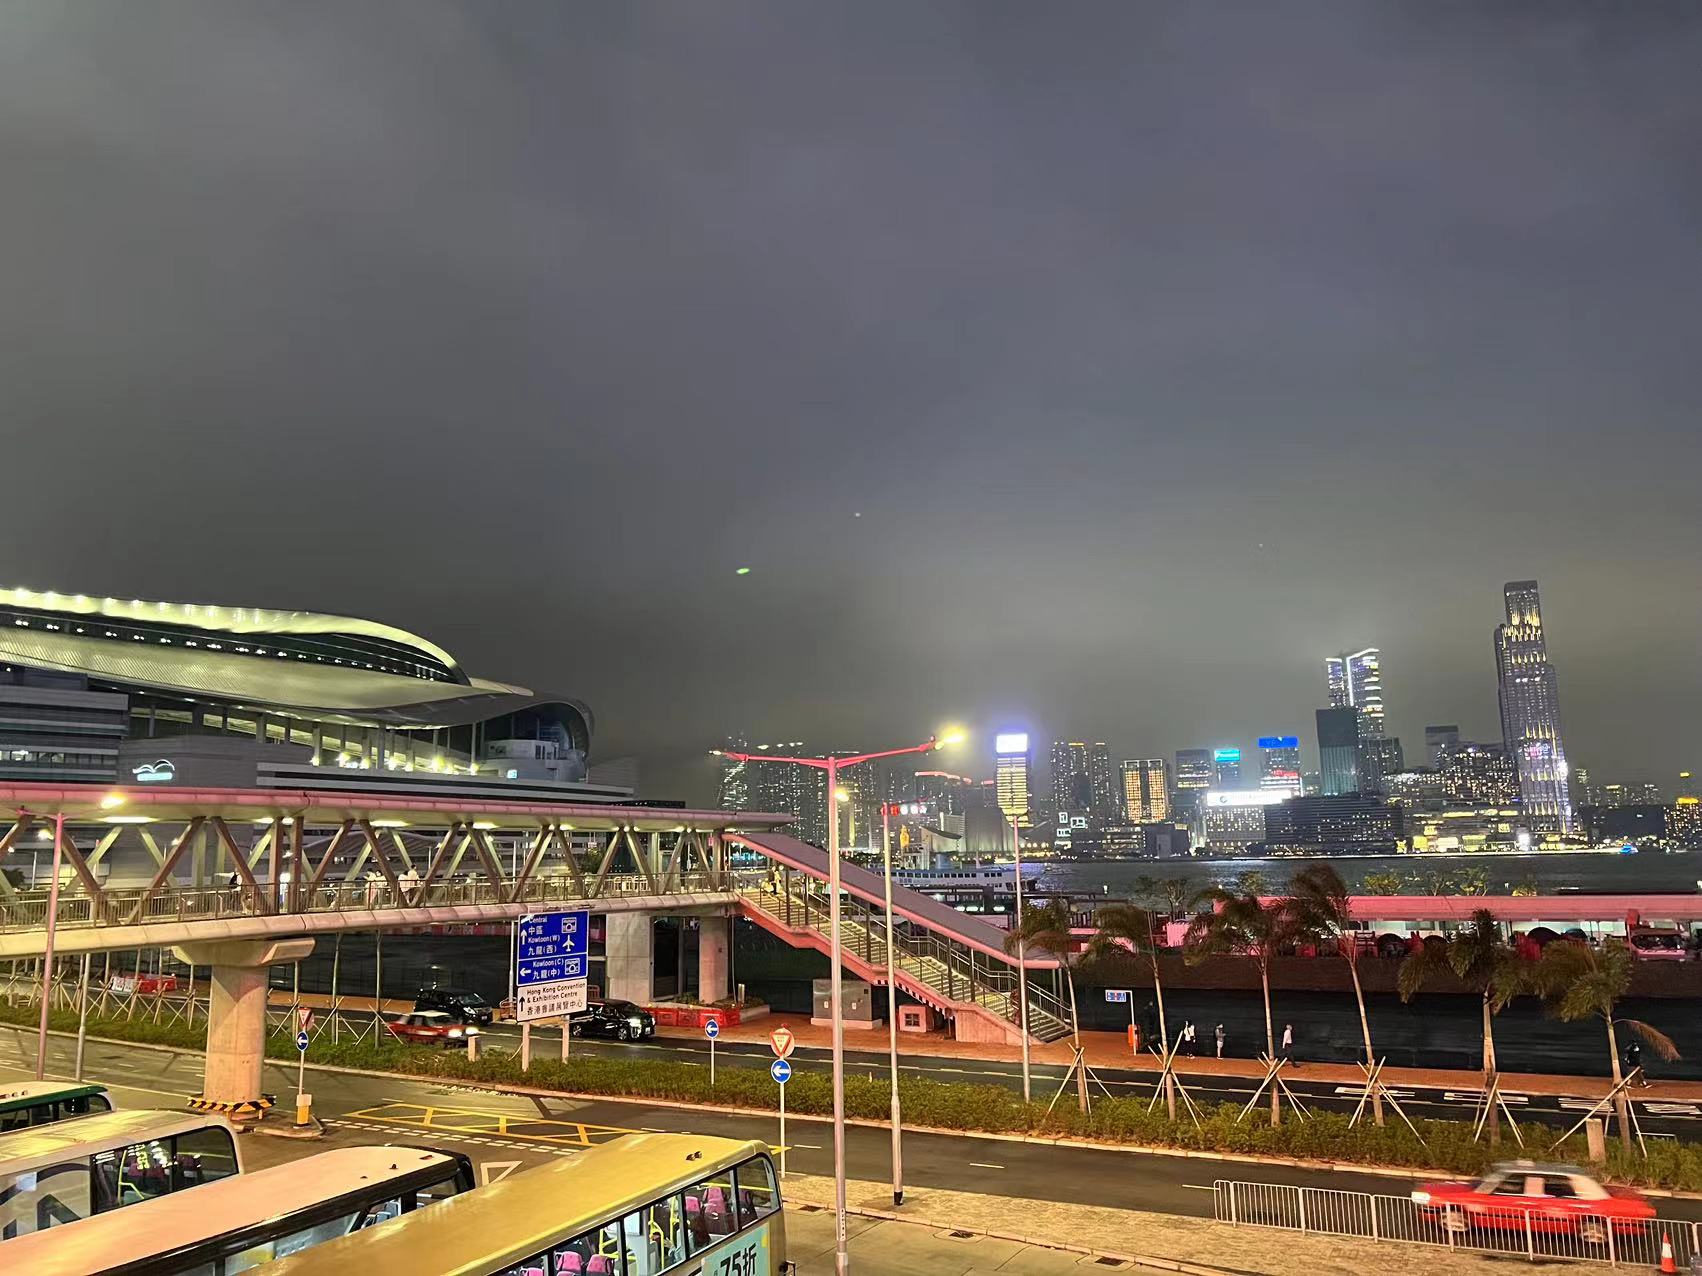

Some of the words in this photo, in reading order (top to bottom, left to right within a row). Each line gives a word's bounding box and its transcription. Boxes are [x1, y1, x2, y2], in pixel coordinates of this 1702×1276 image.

[528, 926, 543, 935] 中區
[557, 982, 586, 992] Convention
[532, 994, 559, 1002] Exhibition
